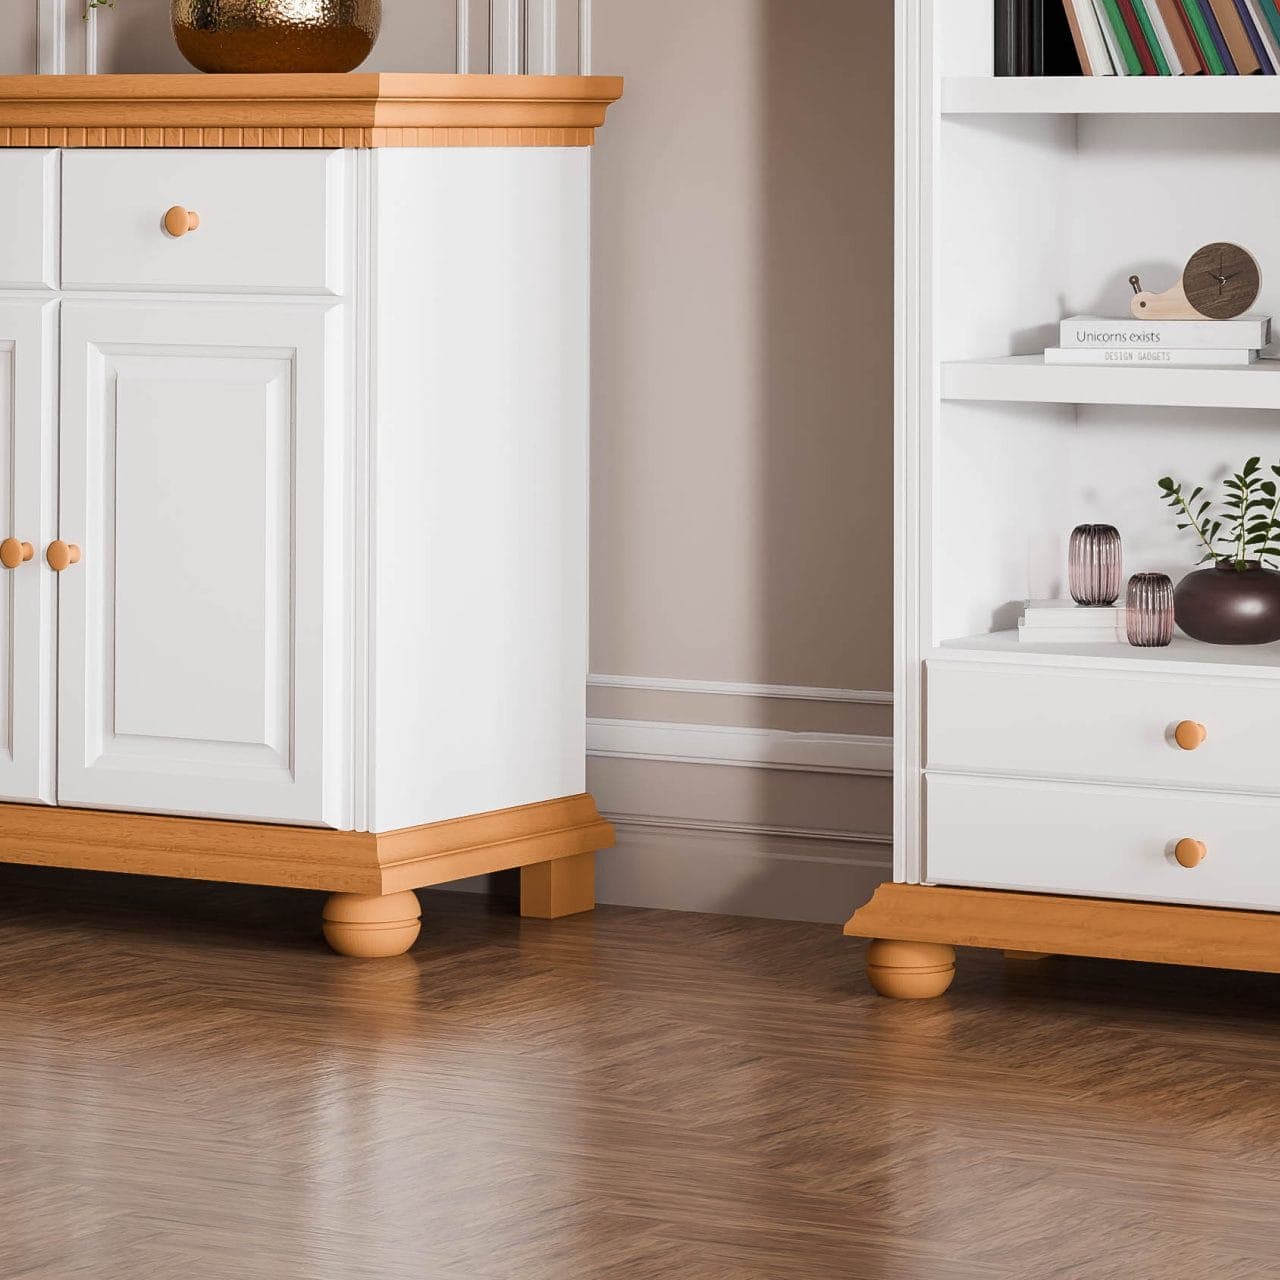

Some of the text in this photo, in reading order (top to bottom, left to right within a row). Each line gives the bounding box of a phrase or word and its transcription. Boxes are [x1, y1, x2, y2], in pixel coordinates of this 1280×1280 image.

[1076, 330, 1161, 343] Unicorns exists
[1105, 351, 1171, 361] DESIGN GADGETS
